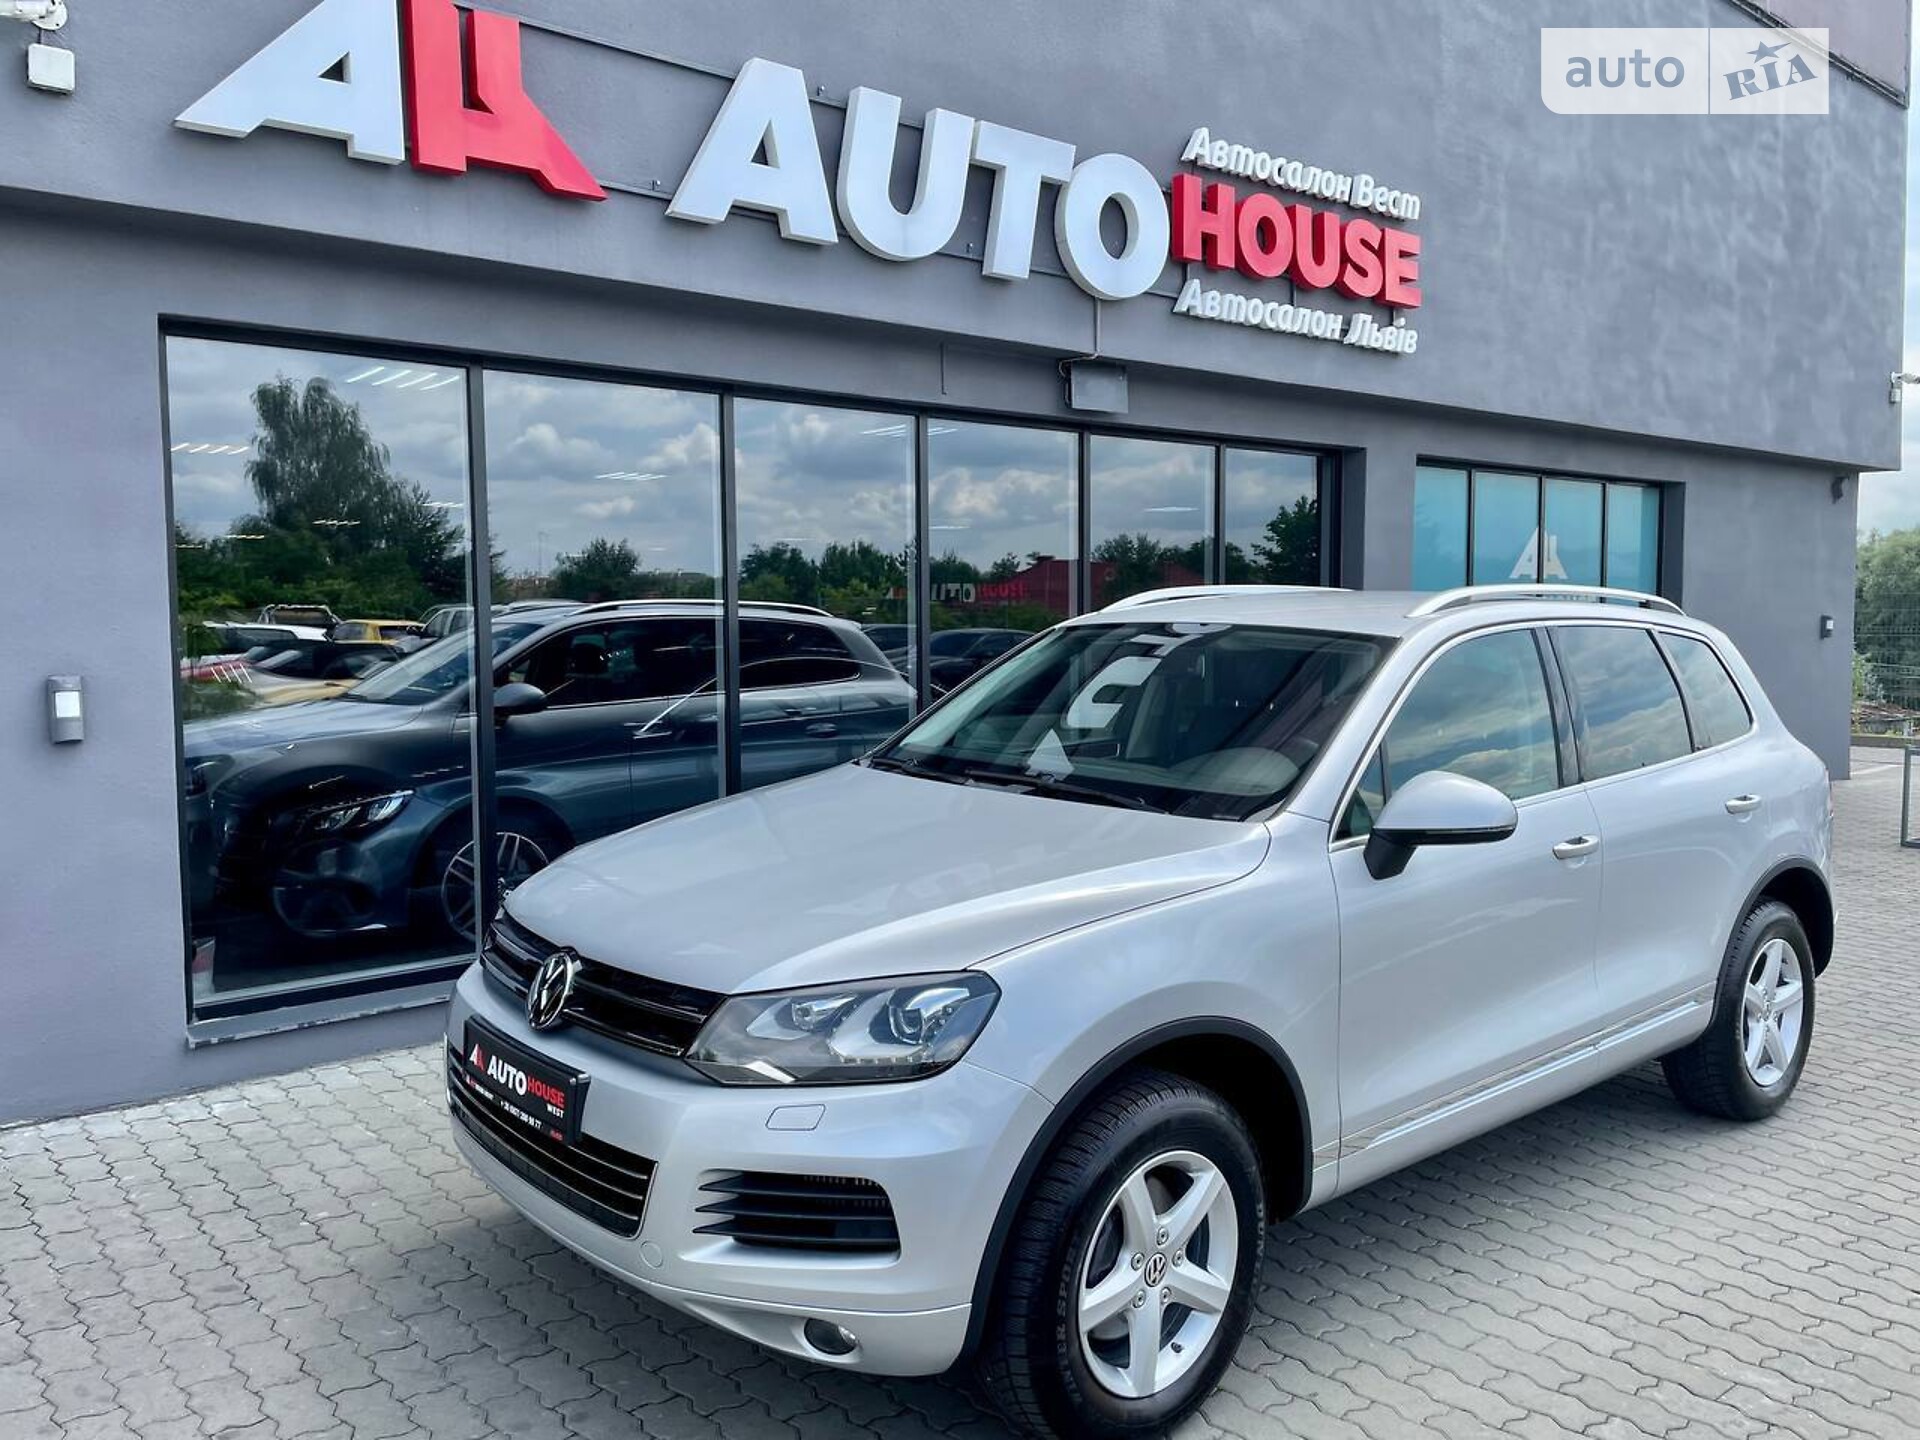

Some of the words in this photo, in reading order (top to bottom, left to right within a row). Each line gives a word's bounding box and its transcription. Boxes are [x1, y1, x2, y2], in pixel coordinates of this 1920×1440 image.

[665, 57, 1170, 299] AUTO
[1172, 172, 1422, 309] HOUSE
[1180, 127, 1351, 204] Автосалон
[1350, 174, 1420, 220] Вест
[1173, 278, 1344, 341] Автосалон
[1343, 312, 1418, 353] Львів
[487, 1055, 528, 1096] AUTO
[528, 1073, 565, 1110] HOUSE
[547, 1103, 565, 1119] WEST
